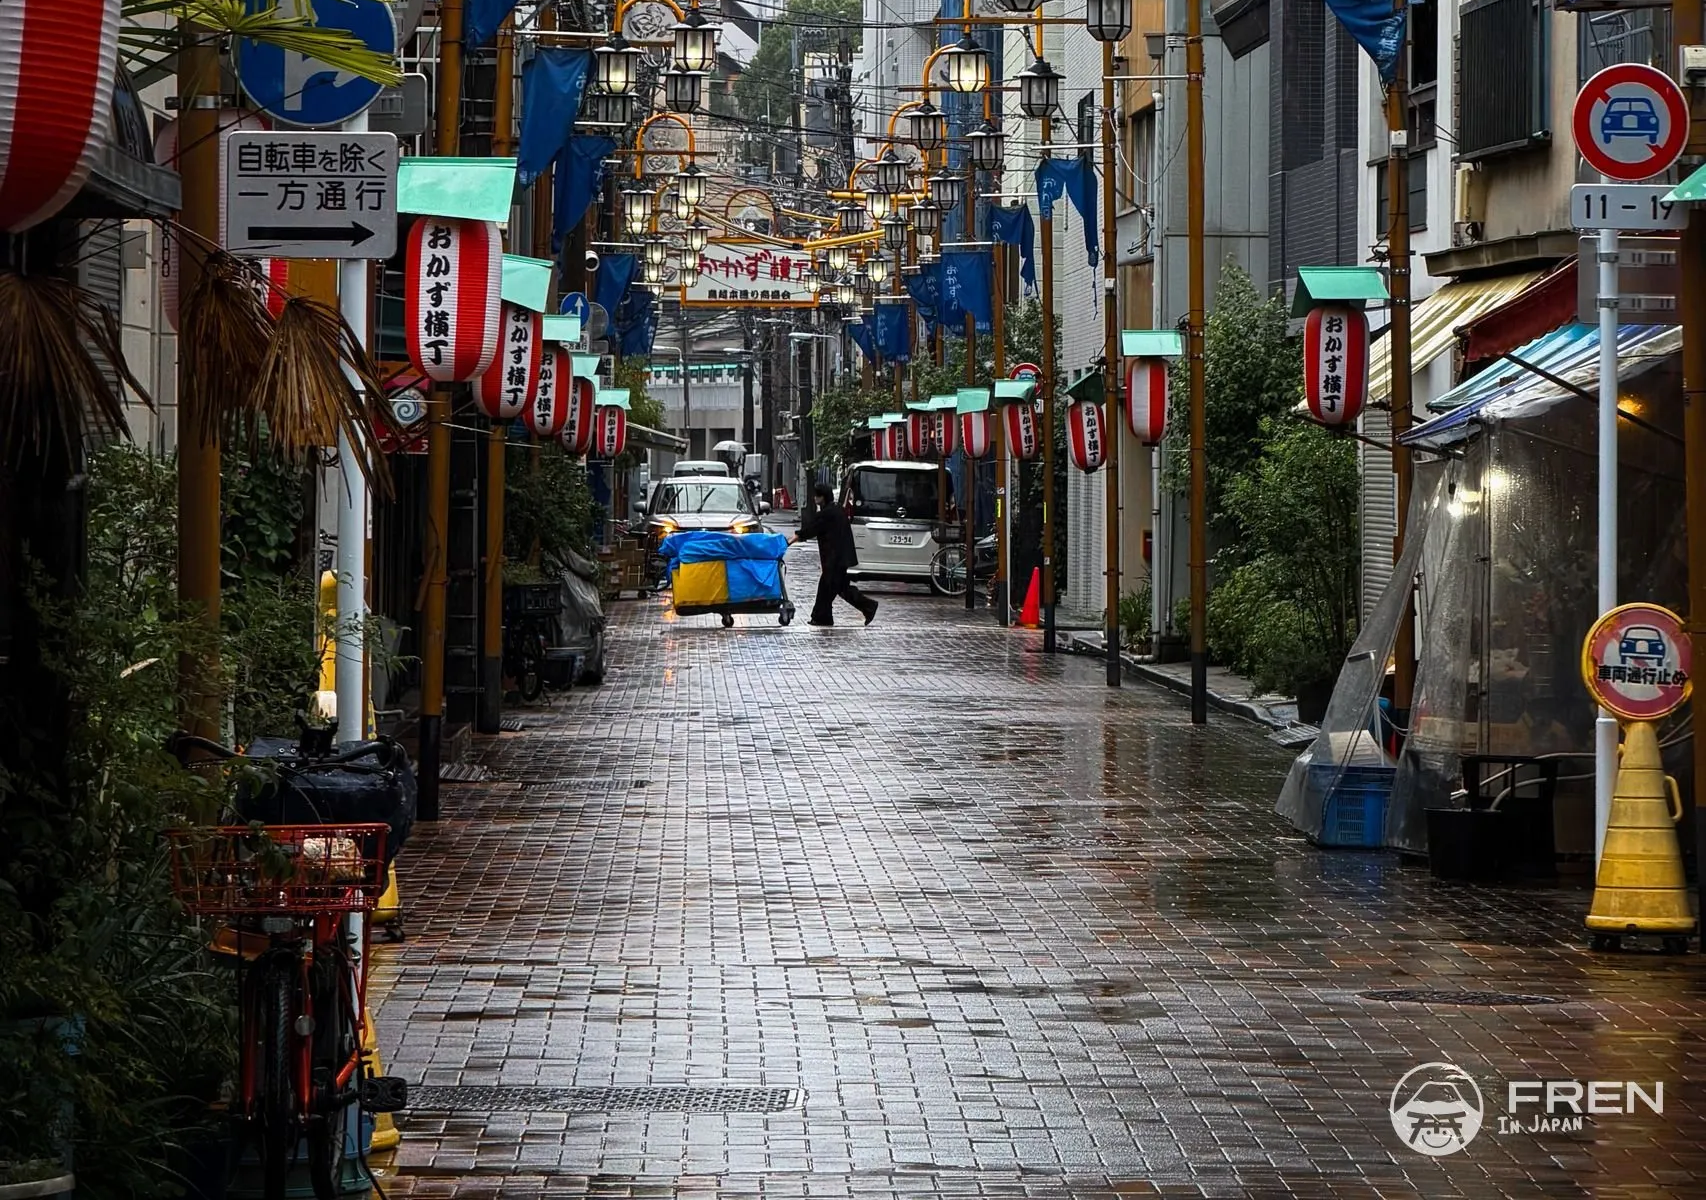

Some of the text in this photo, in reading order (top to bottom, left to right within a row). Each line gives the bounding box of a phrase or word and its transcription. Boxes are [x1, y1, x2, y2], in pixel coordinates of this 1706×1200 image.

[238, 141, 386, 173] 自転車を除く
[238, 180, 386, 211] 一方通行
[423, 226, 451, 366] おかず横丁
[505, 306, 530, 407] おかず横丁
[1323, 316, 1343, 413] おかず横丁
[1598, 665, 1688, 686] 車両通行止め
